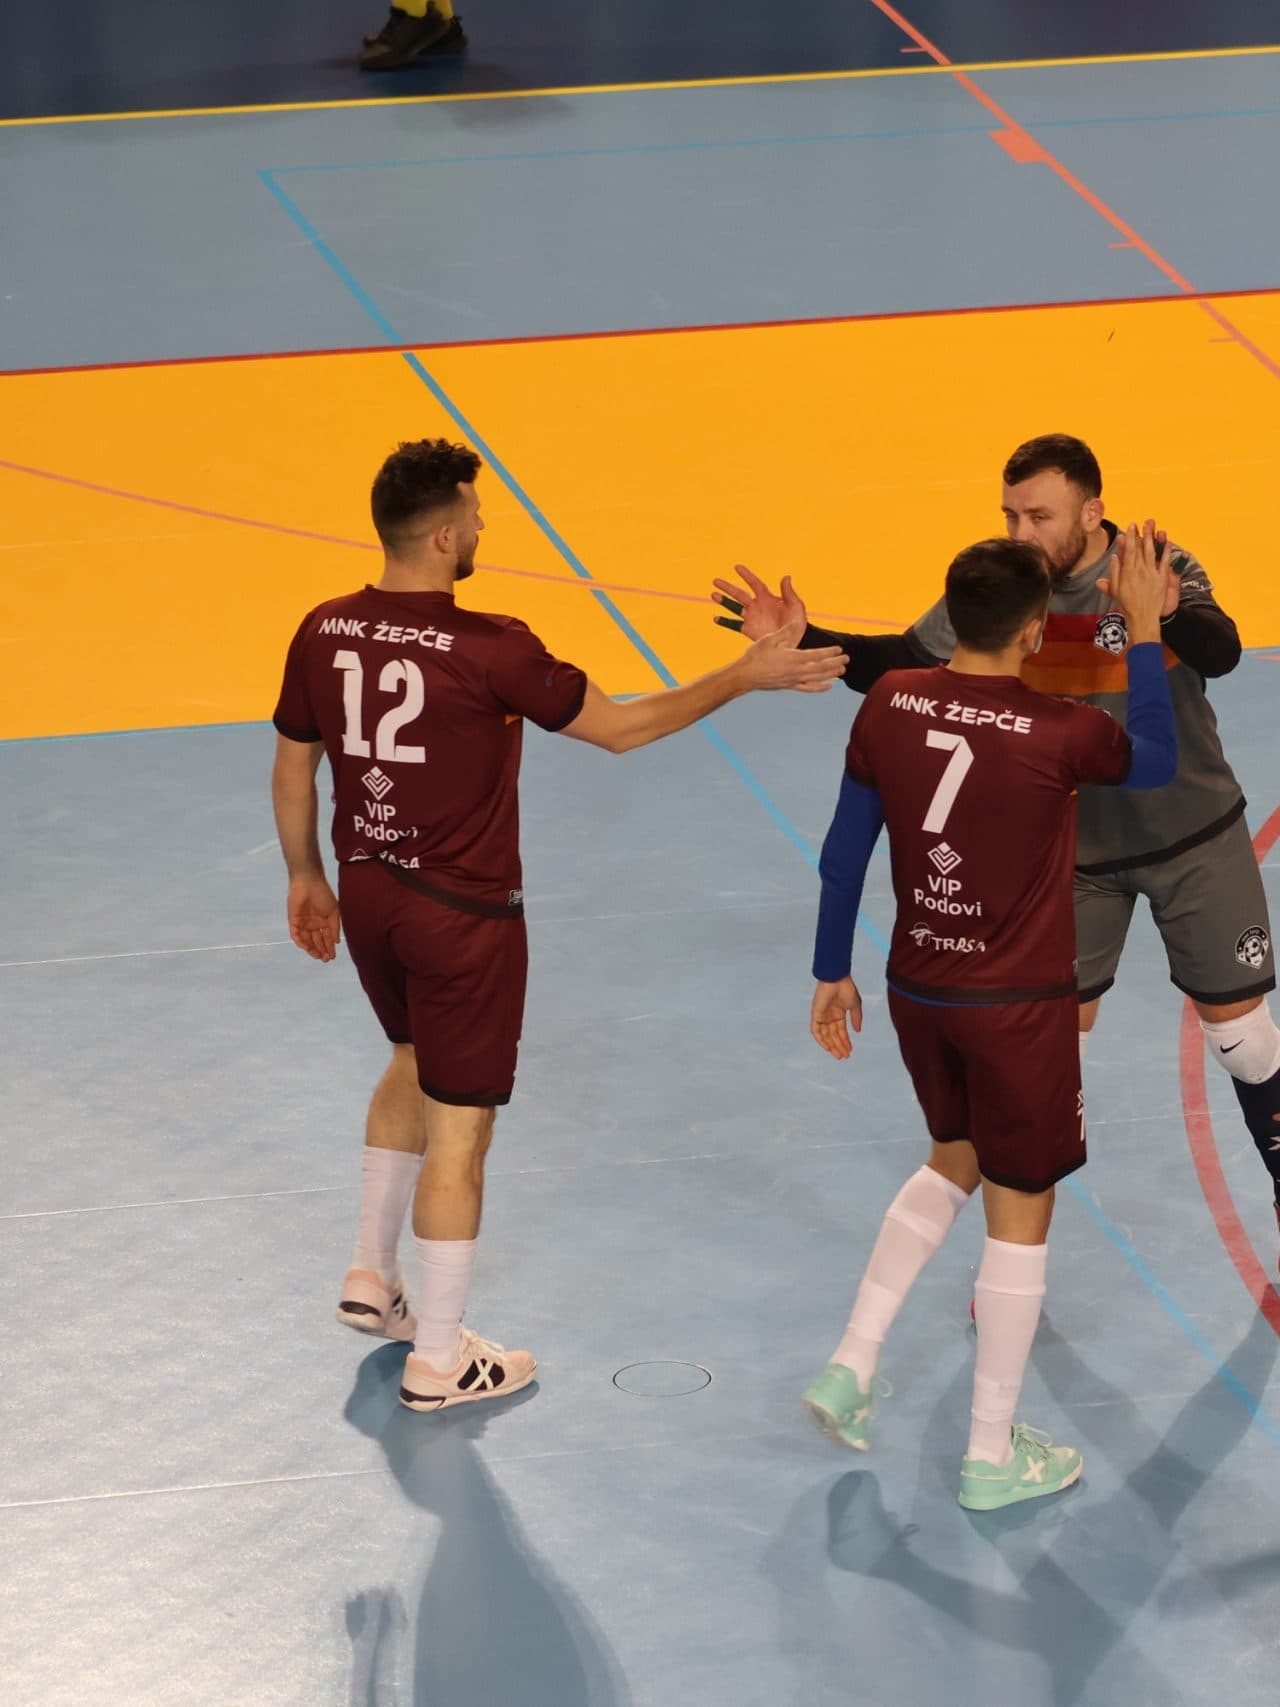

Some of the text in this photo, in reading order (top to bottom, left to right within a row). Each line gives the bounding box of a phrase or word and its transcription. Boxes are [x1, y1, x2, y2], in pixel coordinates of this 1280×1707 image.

[318, 617, 456, 652] MNK ŽEPČE
[332, 649, 426, 764] 12
[890, 691, 1034, 735] MNK ŽEPČE
[921, 729, 975, 834] 7
[364, 799, 397, 823] VIP
[353, 815, 419, 842] Podovi
[927, 874, 963, 897] VIP
[914, 888, 983, 917] Podovi
[931, 936, 987, 953] TRASA
